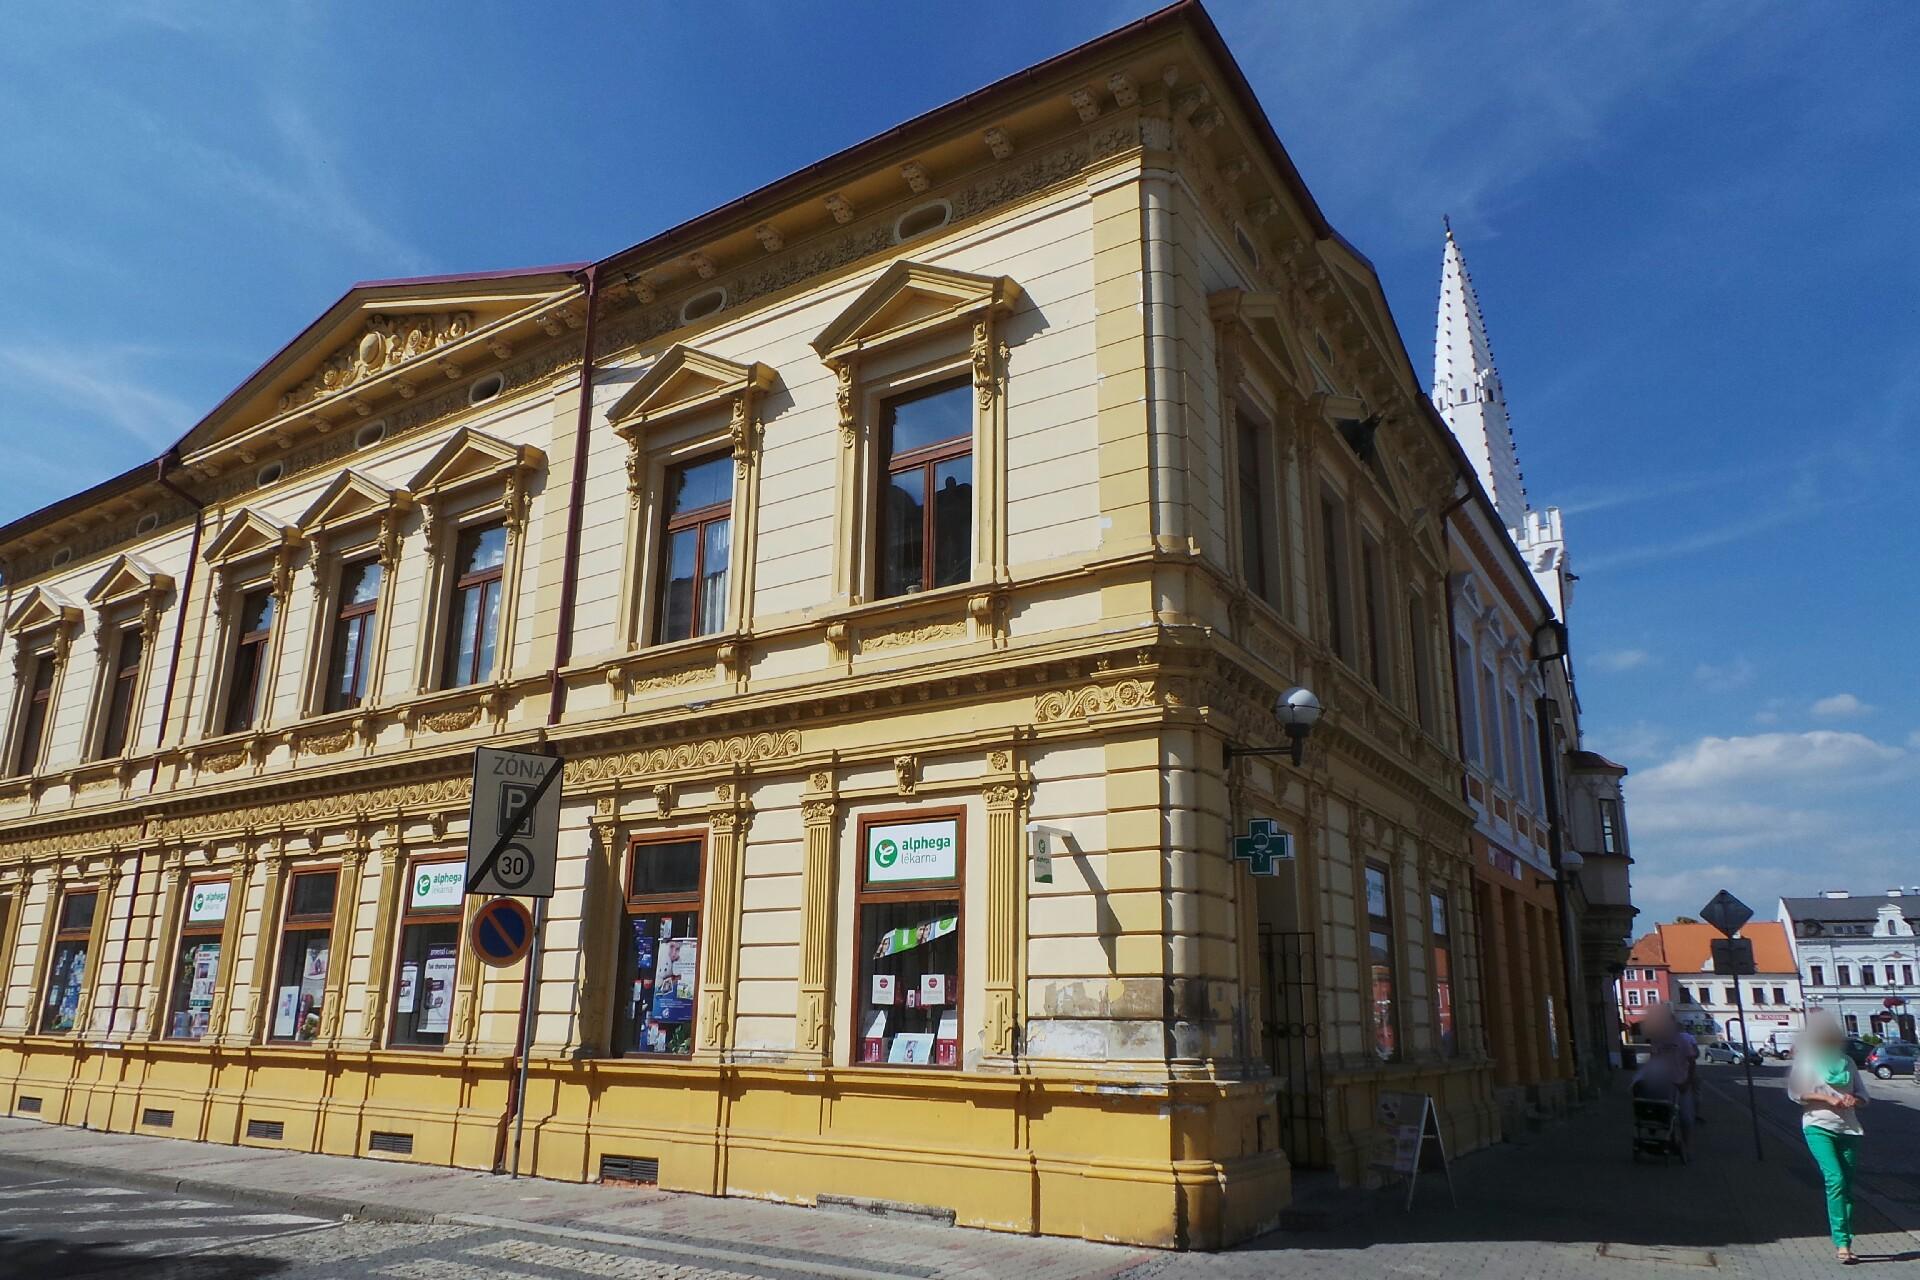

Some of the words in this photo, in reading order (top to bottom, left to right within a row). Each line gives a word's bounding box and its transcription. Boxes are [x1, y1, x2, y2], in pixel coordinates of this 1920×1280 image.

[493, 755, 545, 778] ZÓNA
[505, 788, 527, 819] P
[902, 836, 951, 853] alphega
[501, 856, 524, 876] 30
[433, 872, 462, 885] alphega
